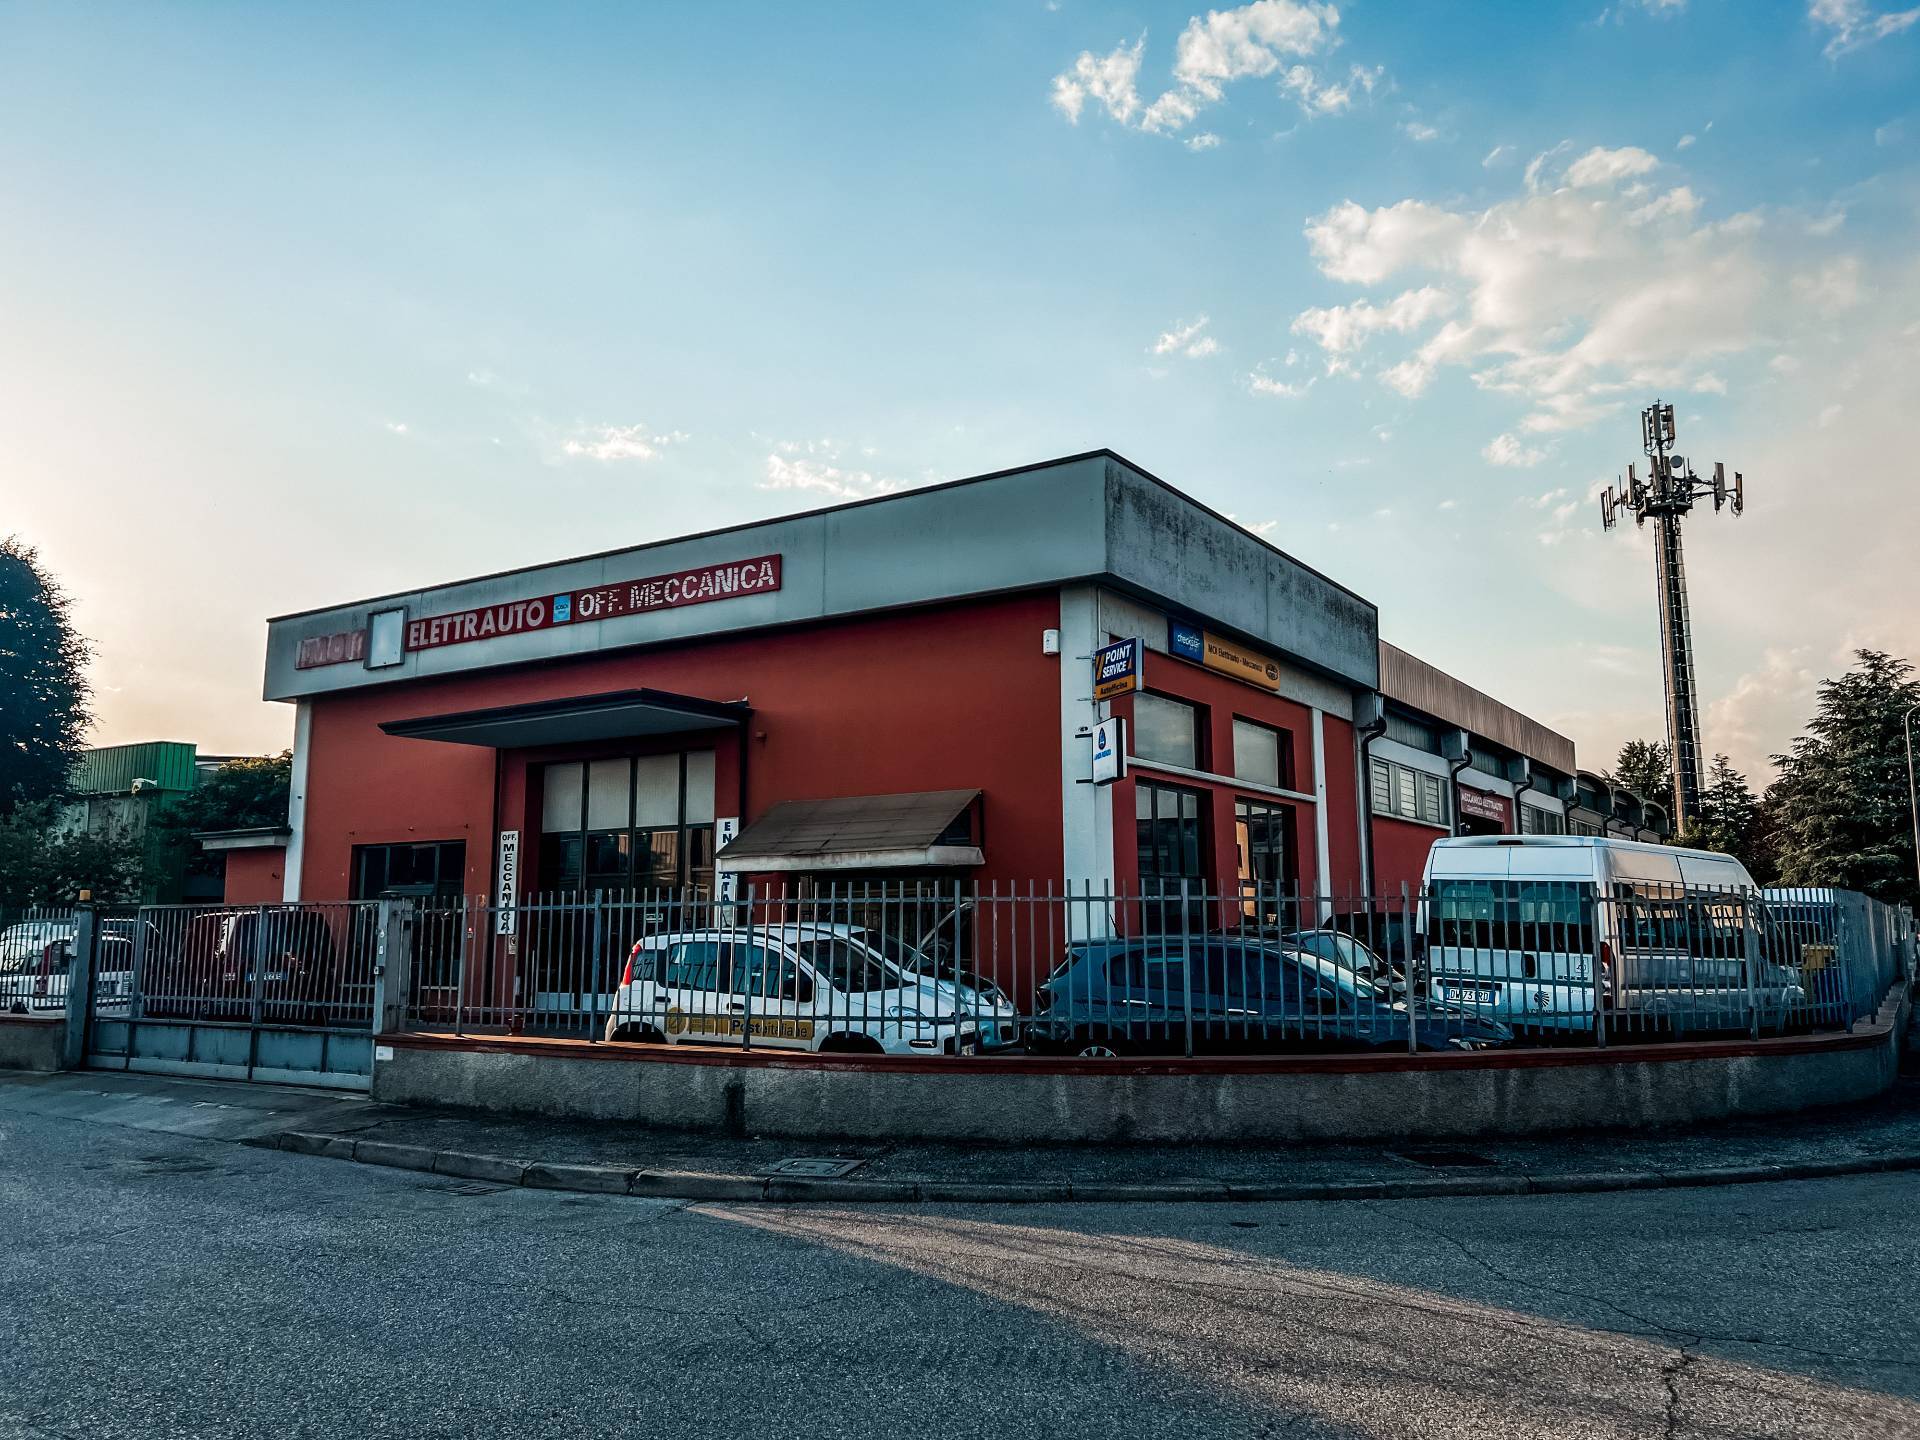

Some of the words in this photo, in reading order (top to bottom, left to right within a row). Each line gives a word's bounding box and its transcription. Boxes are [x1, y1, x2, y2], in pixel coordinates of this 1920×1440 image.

[578, 589, 623, 617] OFF.
[630, 560, 775, 609] MECCANICA
[408, 600, 545, 648] ELETTRAUTO
[1102, 660, 1127, 679] SERVICE
[1105, 643, 1132, 664] POINT
[502, 833, 517, 841] OFF.
[722, 821, 732, 902] ENATA
